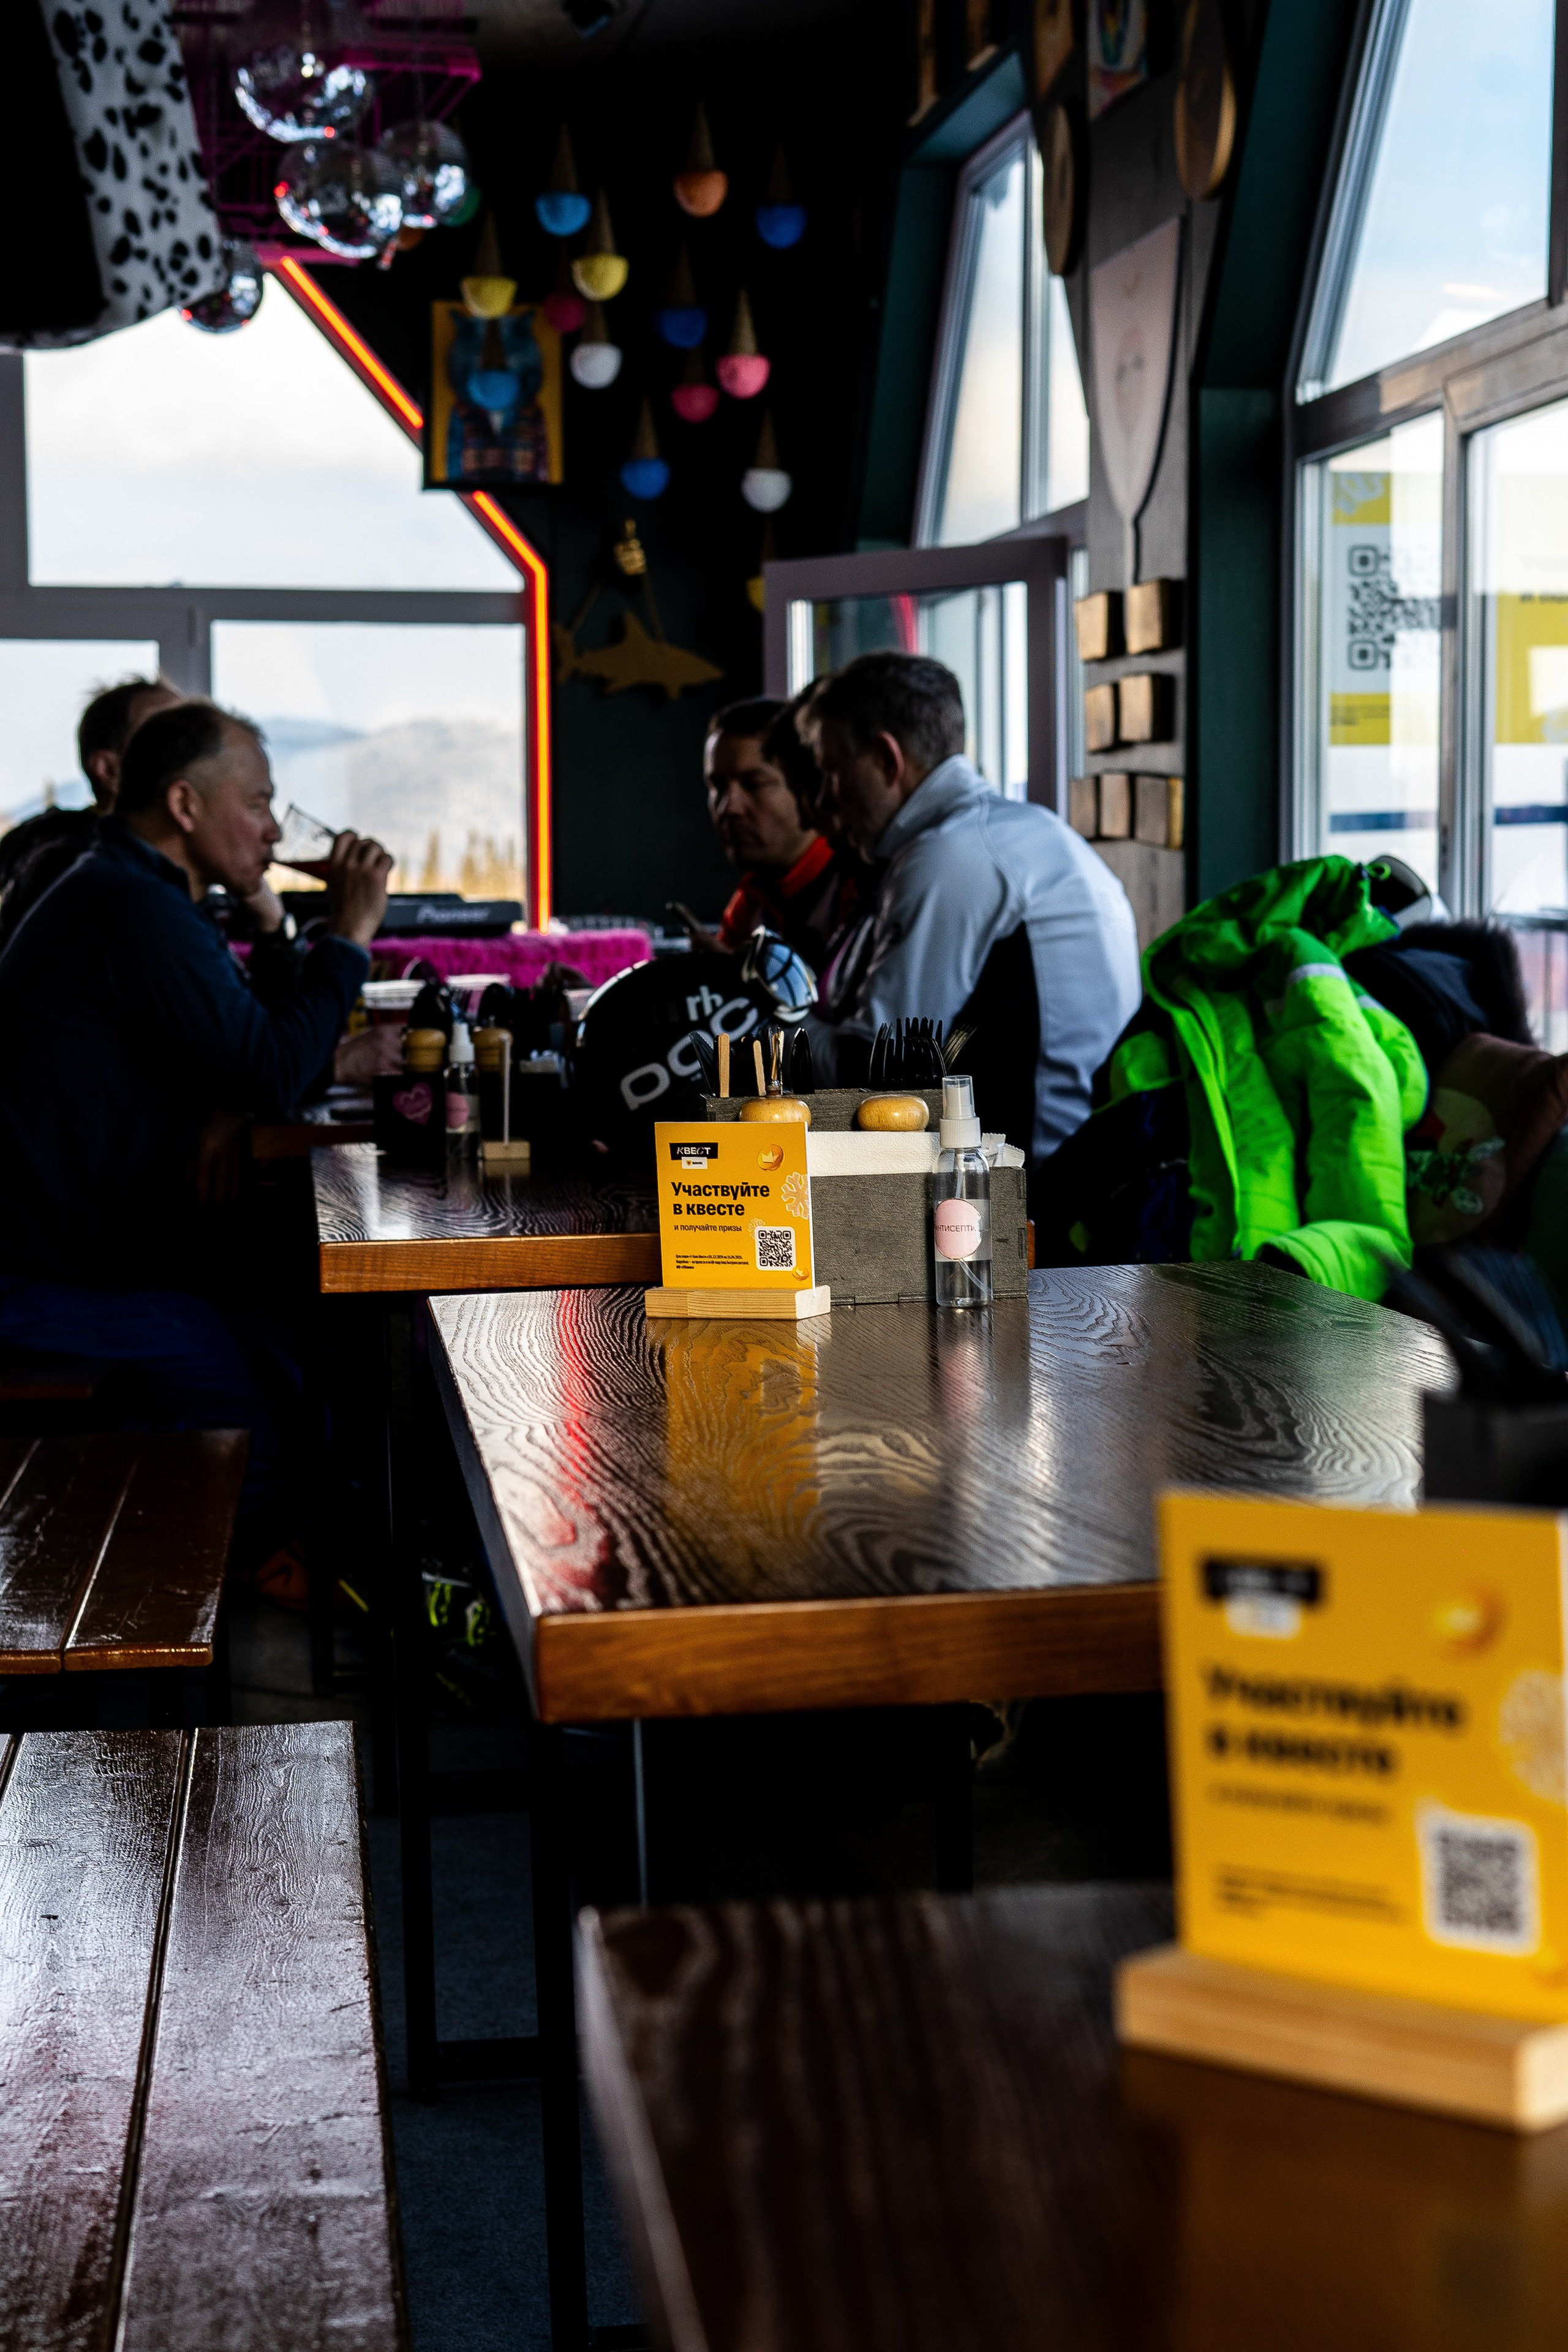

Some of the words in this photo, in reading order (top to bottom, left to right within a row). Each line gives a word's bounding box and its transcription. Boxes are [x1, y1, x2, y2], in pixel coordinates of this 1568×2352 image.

[676, 1147, 711, 1155] КВЕСТ
[671, 1182, 770, 1200] Участвуйте
[673, 1203, 683, 1215] в
[686, 1203, 745, 1216] квесте
[680, 1224, 717, 1233] получайте
